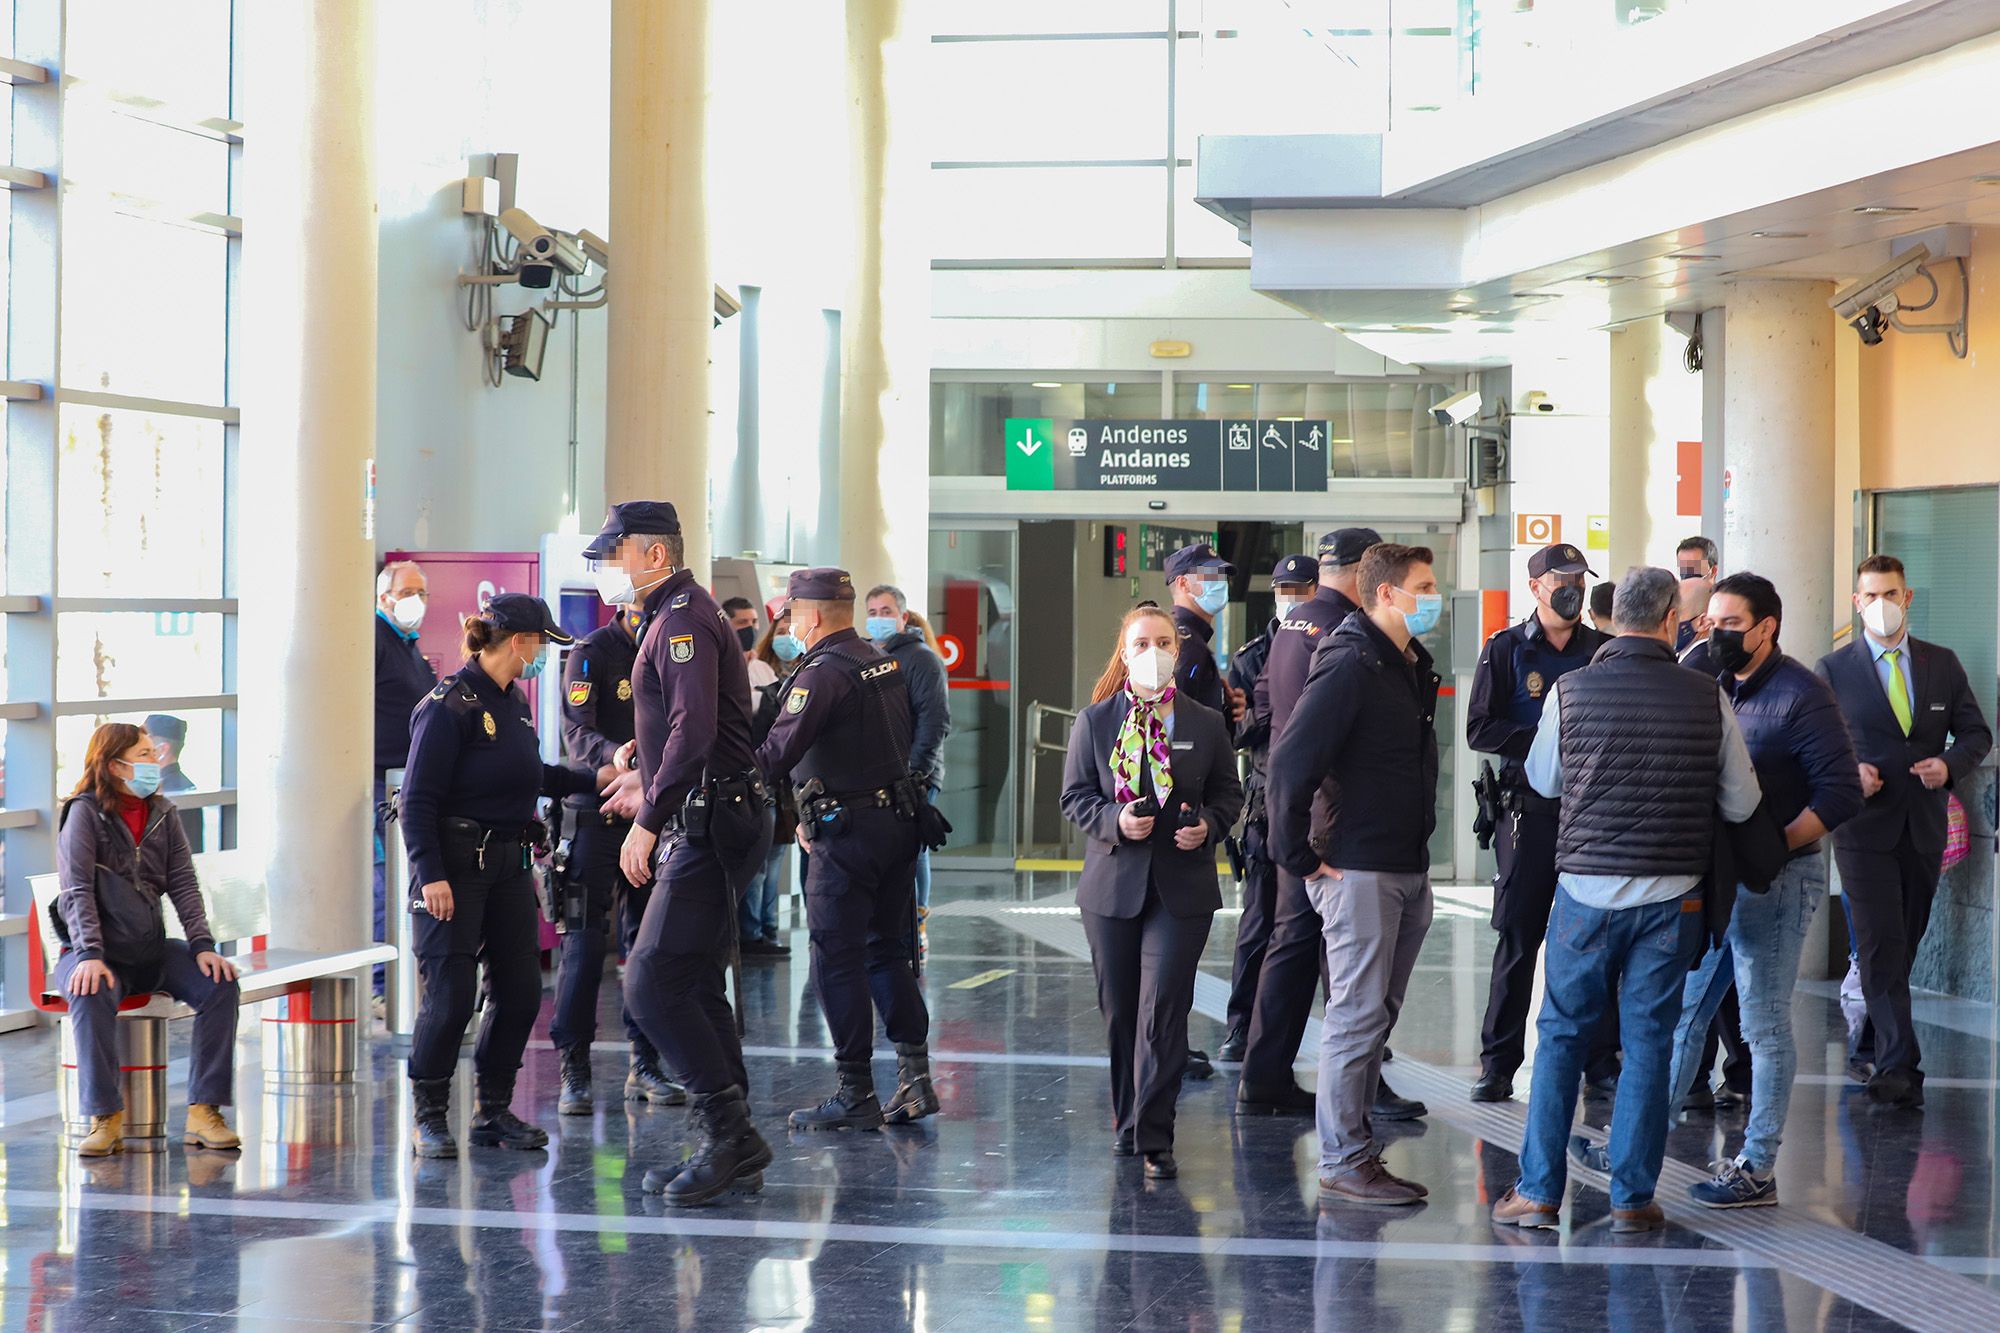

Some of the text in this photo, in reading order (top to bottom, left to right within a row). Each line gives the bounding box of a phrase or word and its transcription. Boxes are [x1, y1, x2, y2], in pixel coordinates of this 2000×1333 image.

[1100, 425, 1188, 444] Andenes
[1100, 449, 1191, 468] Andanes
[1100, 474, 1157, 485] PLATFORMS
